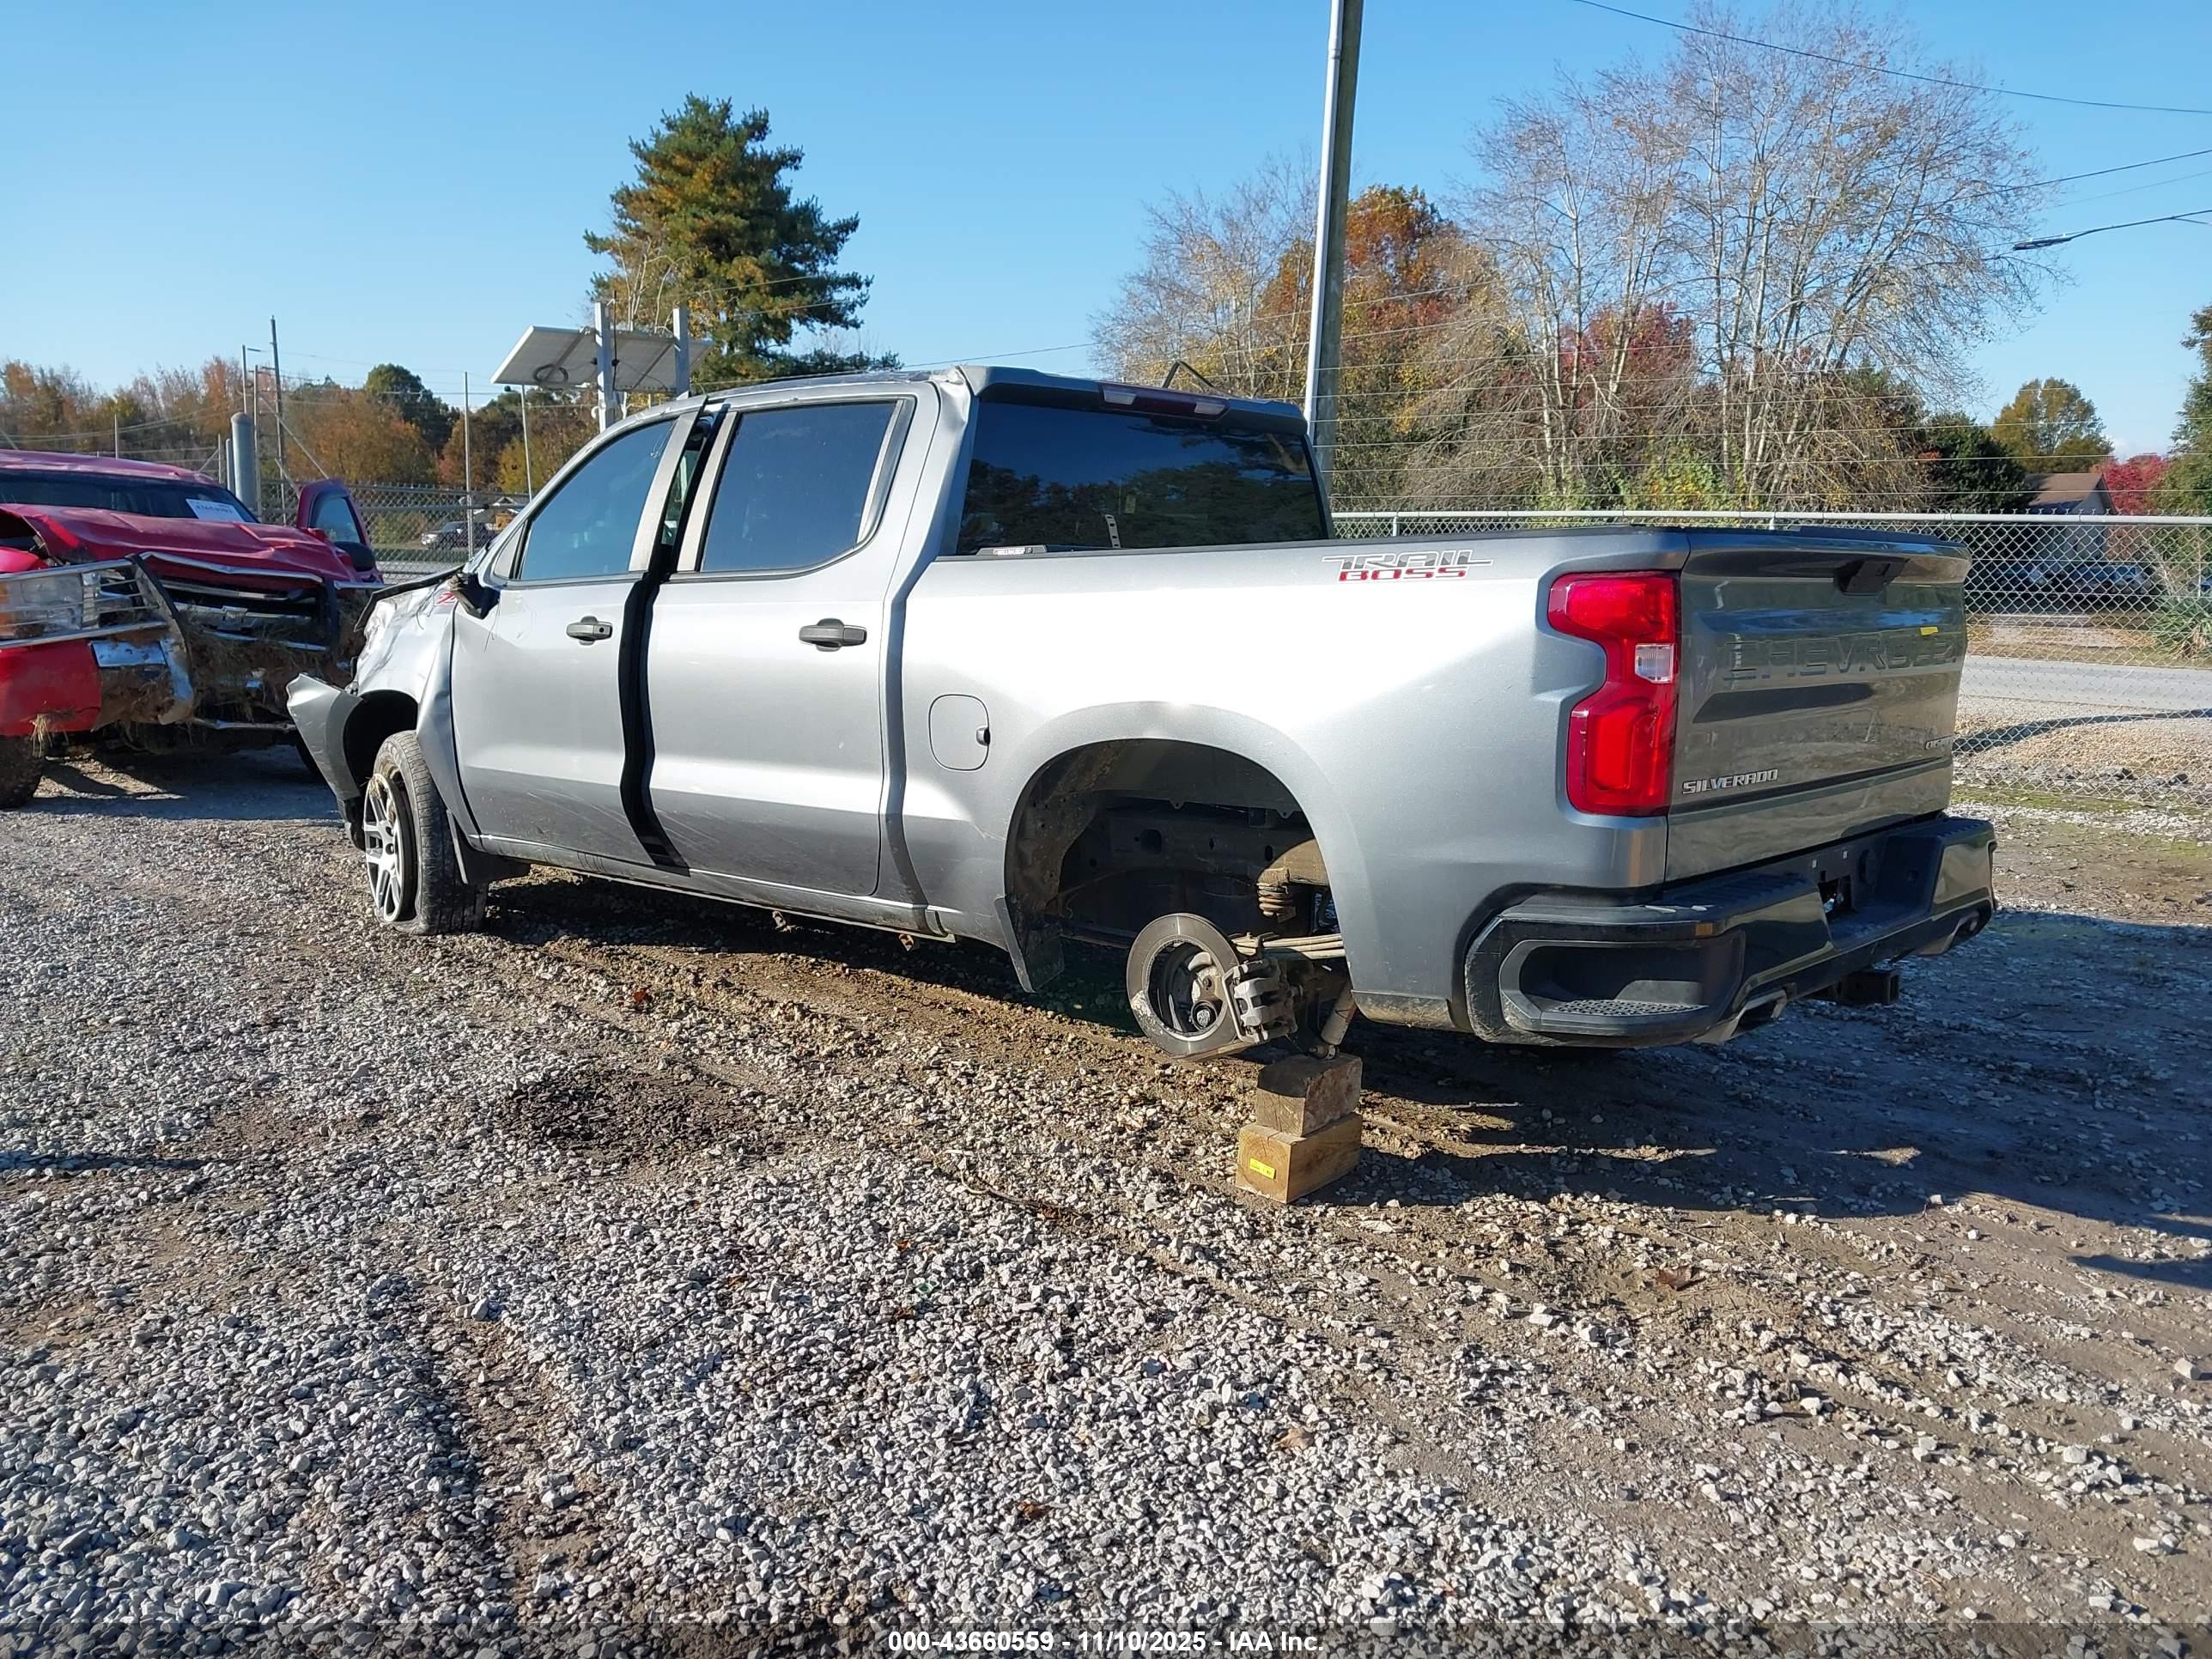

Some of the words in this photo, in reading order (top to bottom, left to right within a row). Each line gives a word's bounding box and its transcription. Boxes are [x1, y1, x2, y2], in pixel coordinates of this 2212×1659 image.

[1322, 550, 1493, 569] TRAIL
[1338, 567, 1470, 583] BOSS
[1682, 769, 1778, 794] SILVERADO
